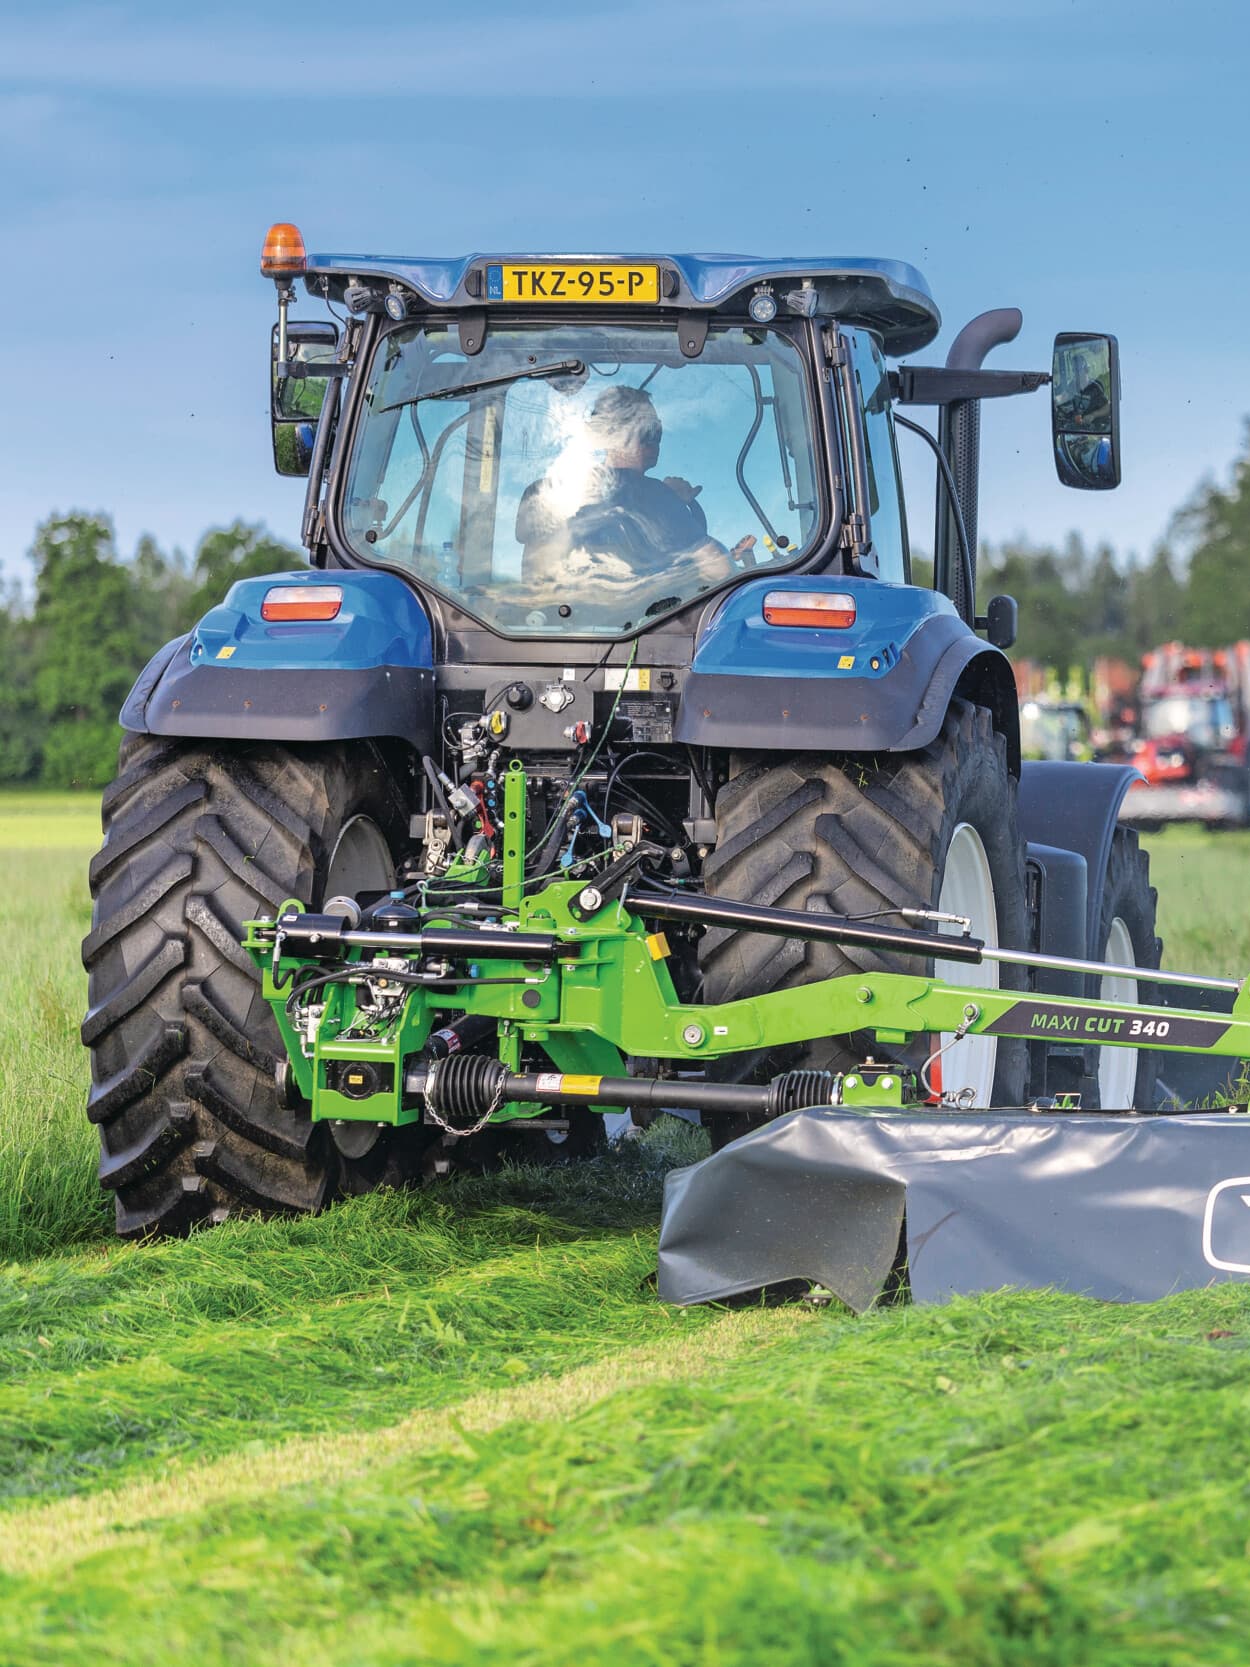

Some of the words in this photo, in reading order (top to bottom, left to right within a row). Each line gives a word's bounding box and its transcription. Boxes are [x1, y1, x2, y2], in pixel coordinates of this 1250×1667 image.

[489, 285, 501, 295] NL
[512, 271, 644, 296] TKZ-95-P
[1031, 1013, 1078, 1031] MAXI
[1084, 1017, 1125, 1034] CUT
[1129, 1019, 1170, 1037] 340
